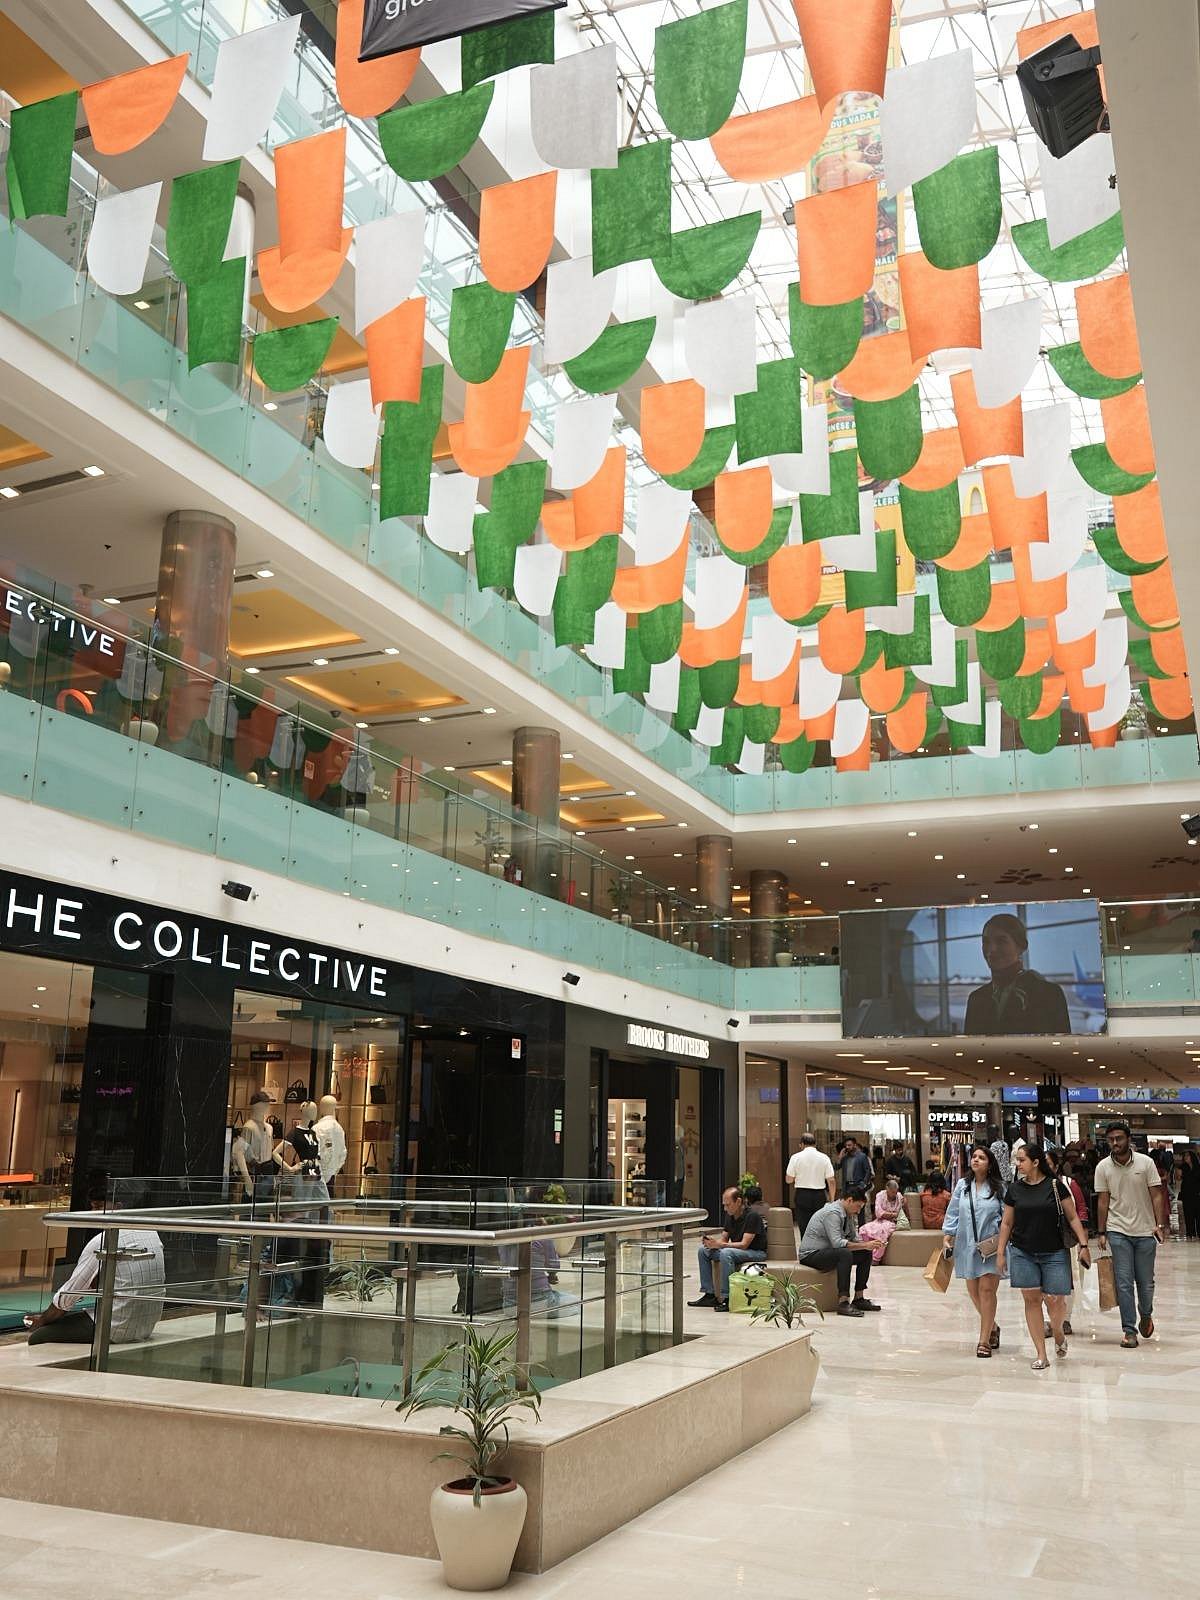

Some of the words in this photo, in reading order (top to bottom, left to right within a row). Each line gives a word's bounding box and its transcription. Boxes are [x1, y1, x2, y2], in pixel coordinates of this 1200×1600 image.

[6, 888, 83, 940] HE
[113, 911, 387, 997] COLLECTIVE
[628, 1024, 665, 1050] BROOKS
[666, 1033, 710, 1059] BROTHERS
[928, 1112, 968, 1122] OPPERS
